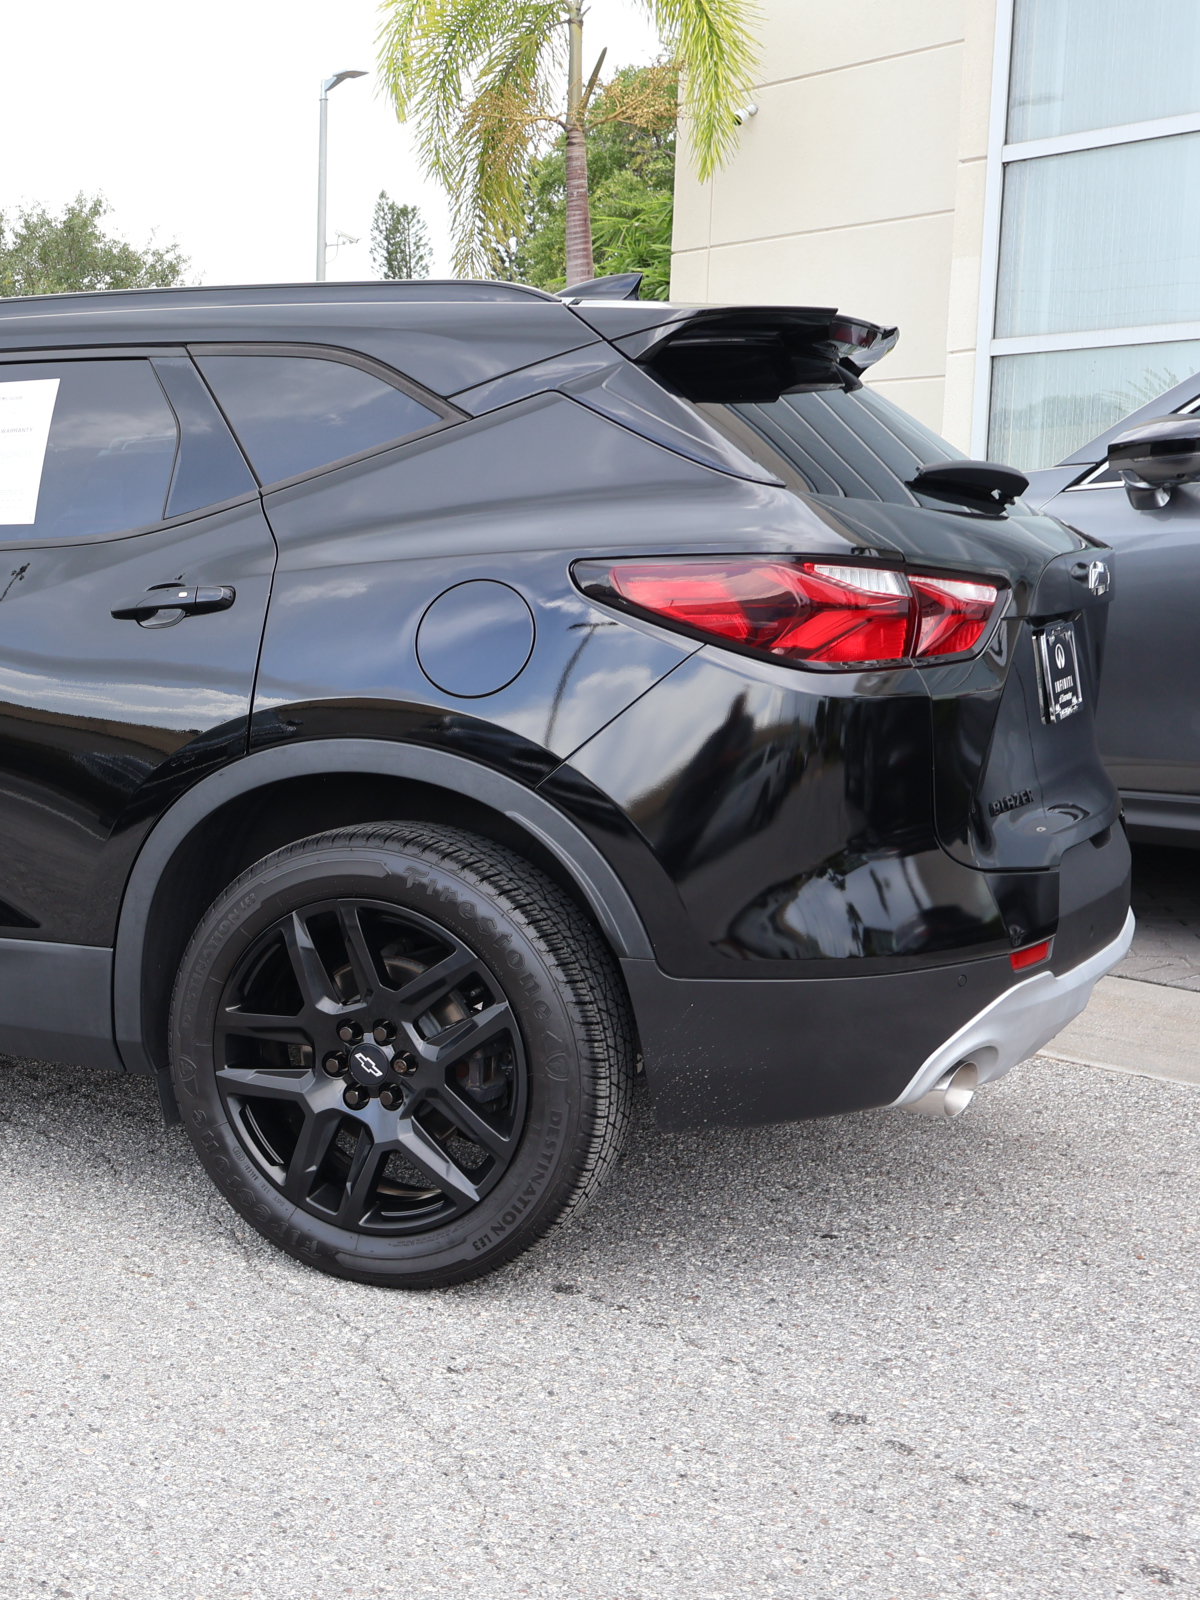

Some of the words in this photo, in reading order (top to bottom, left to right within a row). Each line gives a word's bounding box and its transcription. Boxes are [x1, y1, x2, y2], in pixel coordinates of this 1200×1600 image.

[402, 865, 553, 1020] Firestone
[491, 1110, 562, 1236] DESTINATION
[472, 1233, 493, 1252] LE3
